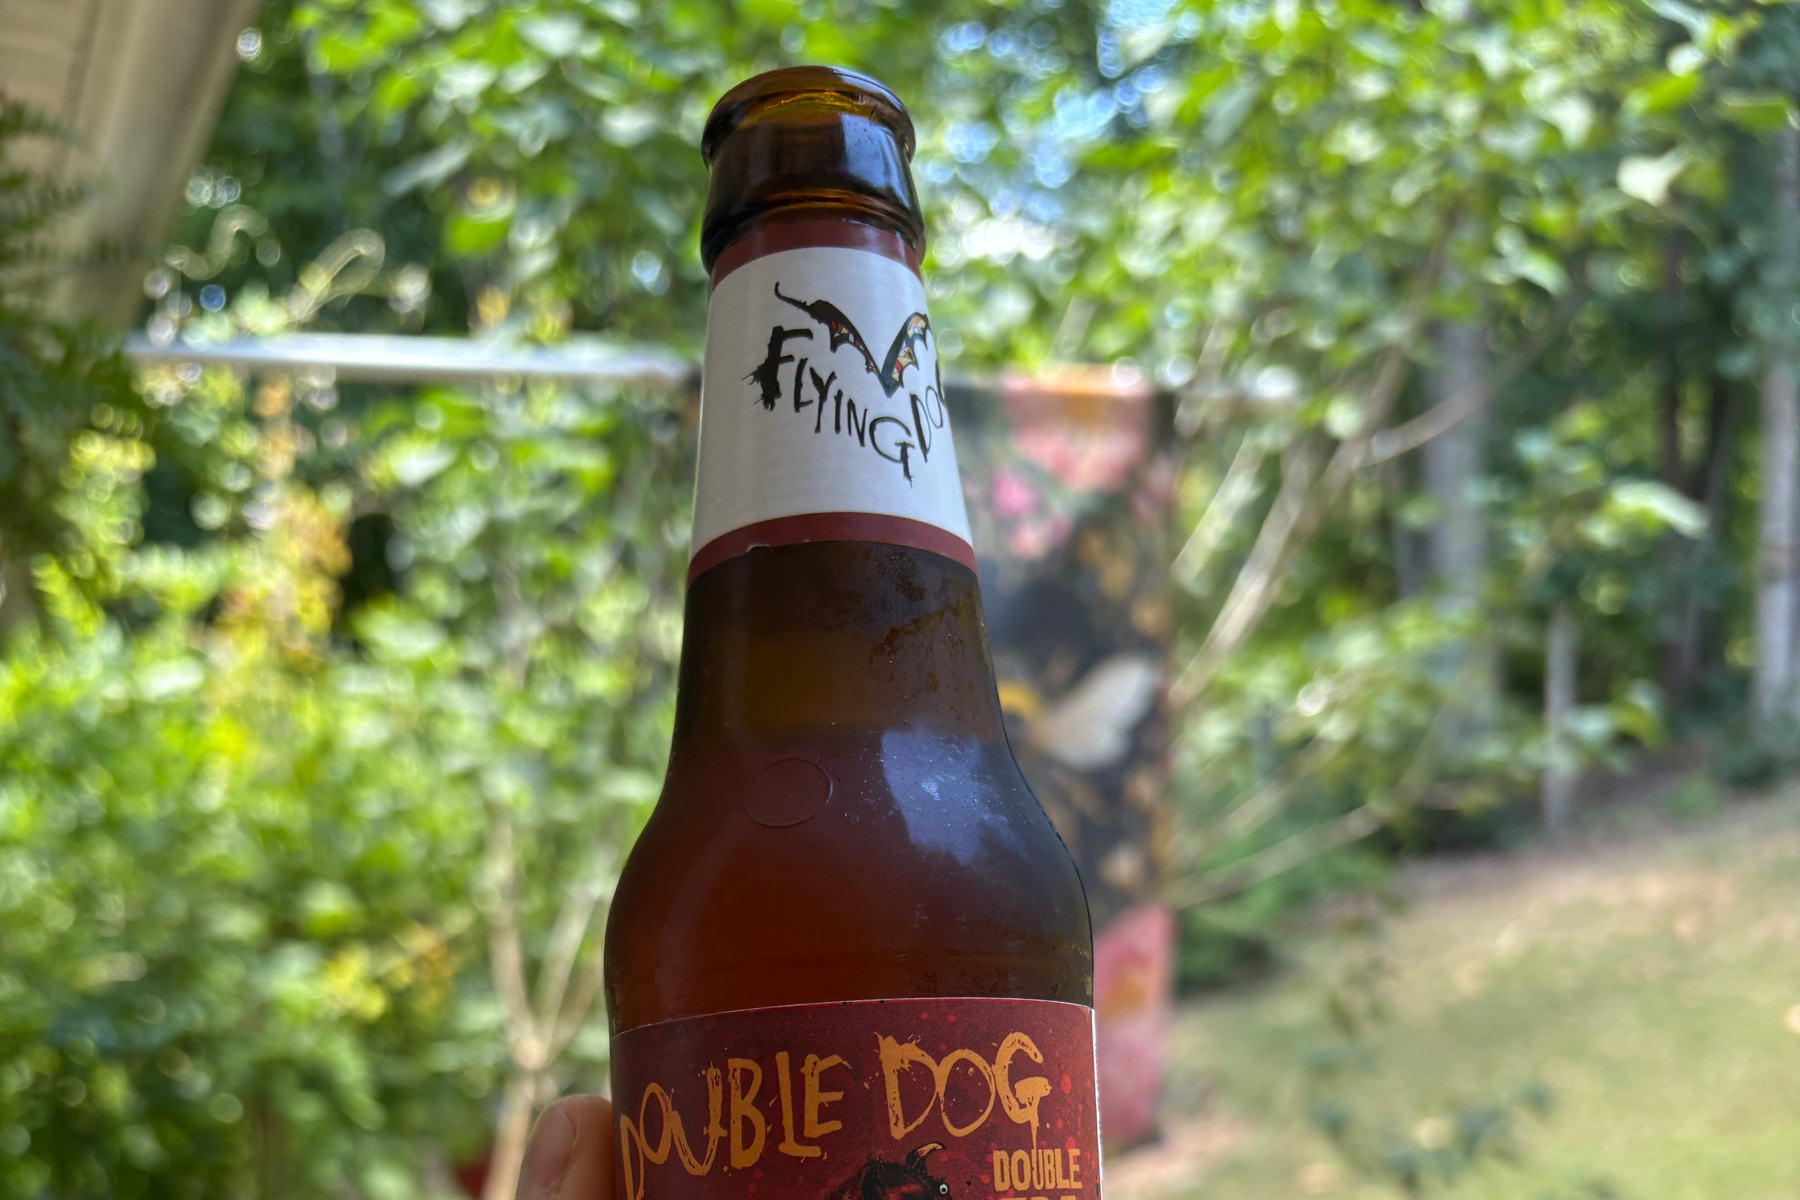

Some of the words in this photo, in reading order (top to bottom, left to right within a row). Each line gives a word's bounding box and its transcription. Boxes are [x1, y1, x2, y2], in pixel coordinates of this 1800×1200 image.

[742, 326, 914, 488] FLYING
[909, 360, 947, 463] DO
[875, 1032, 1052, 1147] DOG
[993, 1149, 1082, 1192] DOUBLE
